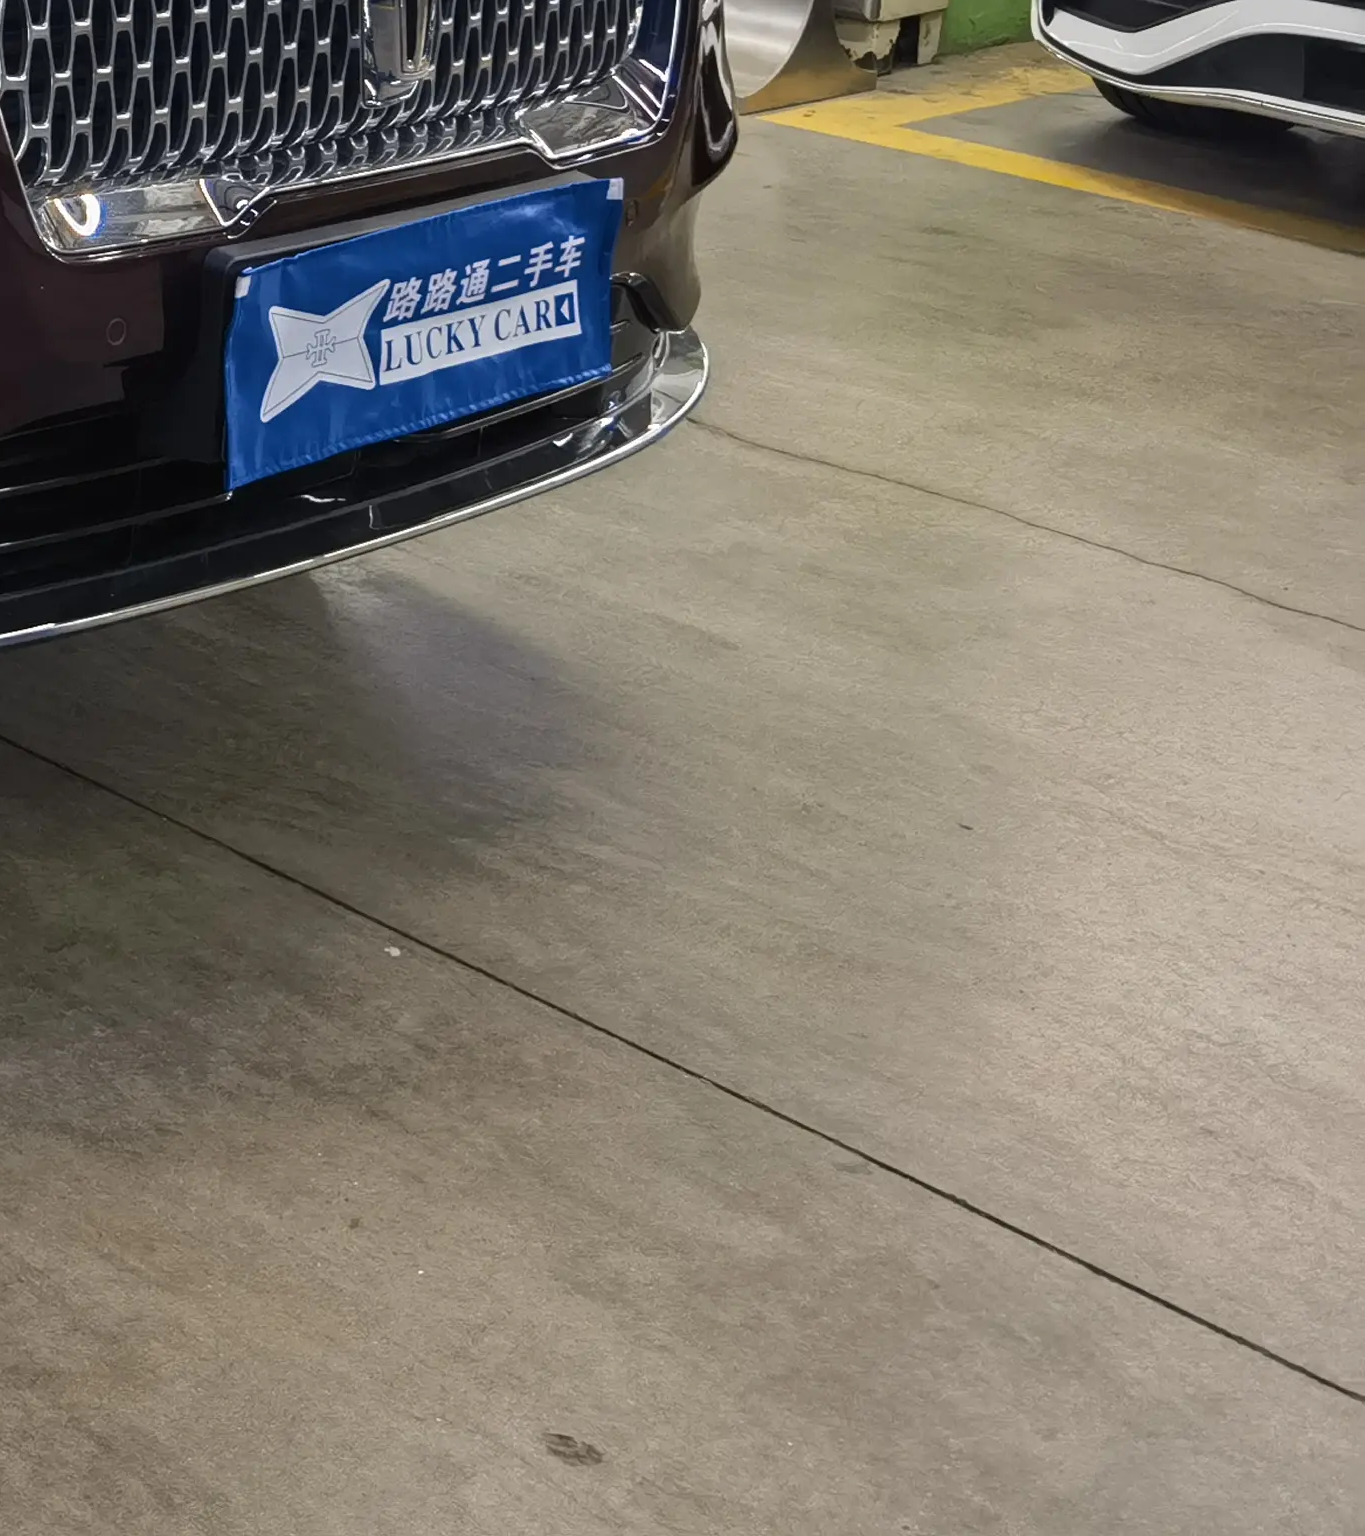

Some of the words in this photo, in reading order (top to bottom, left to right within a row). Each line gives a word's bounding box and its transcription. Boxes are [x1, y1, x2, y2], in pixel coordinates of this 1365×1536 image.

[382, 234, 587, 323] 路路通二手车
[382, 314, 486, 373] LUCKY
[494, 298, 553, 342] CAR
